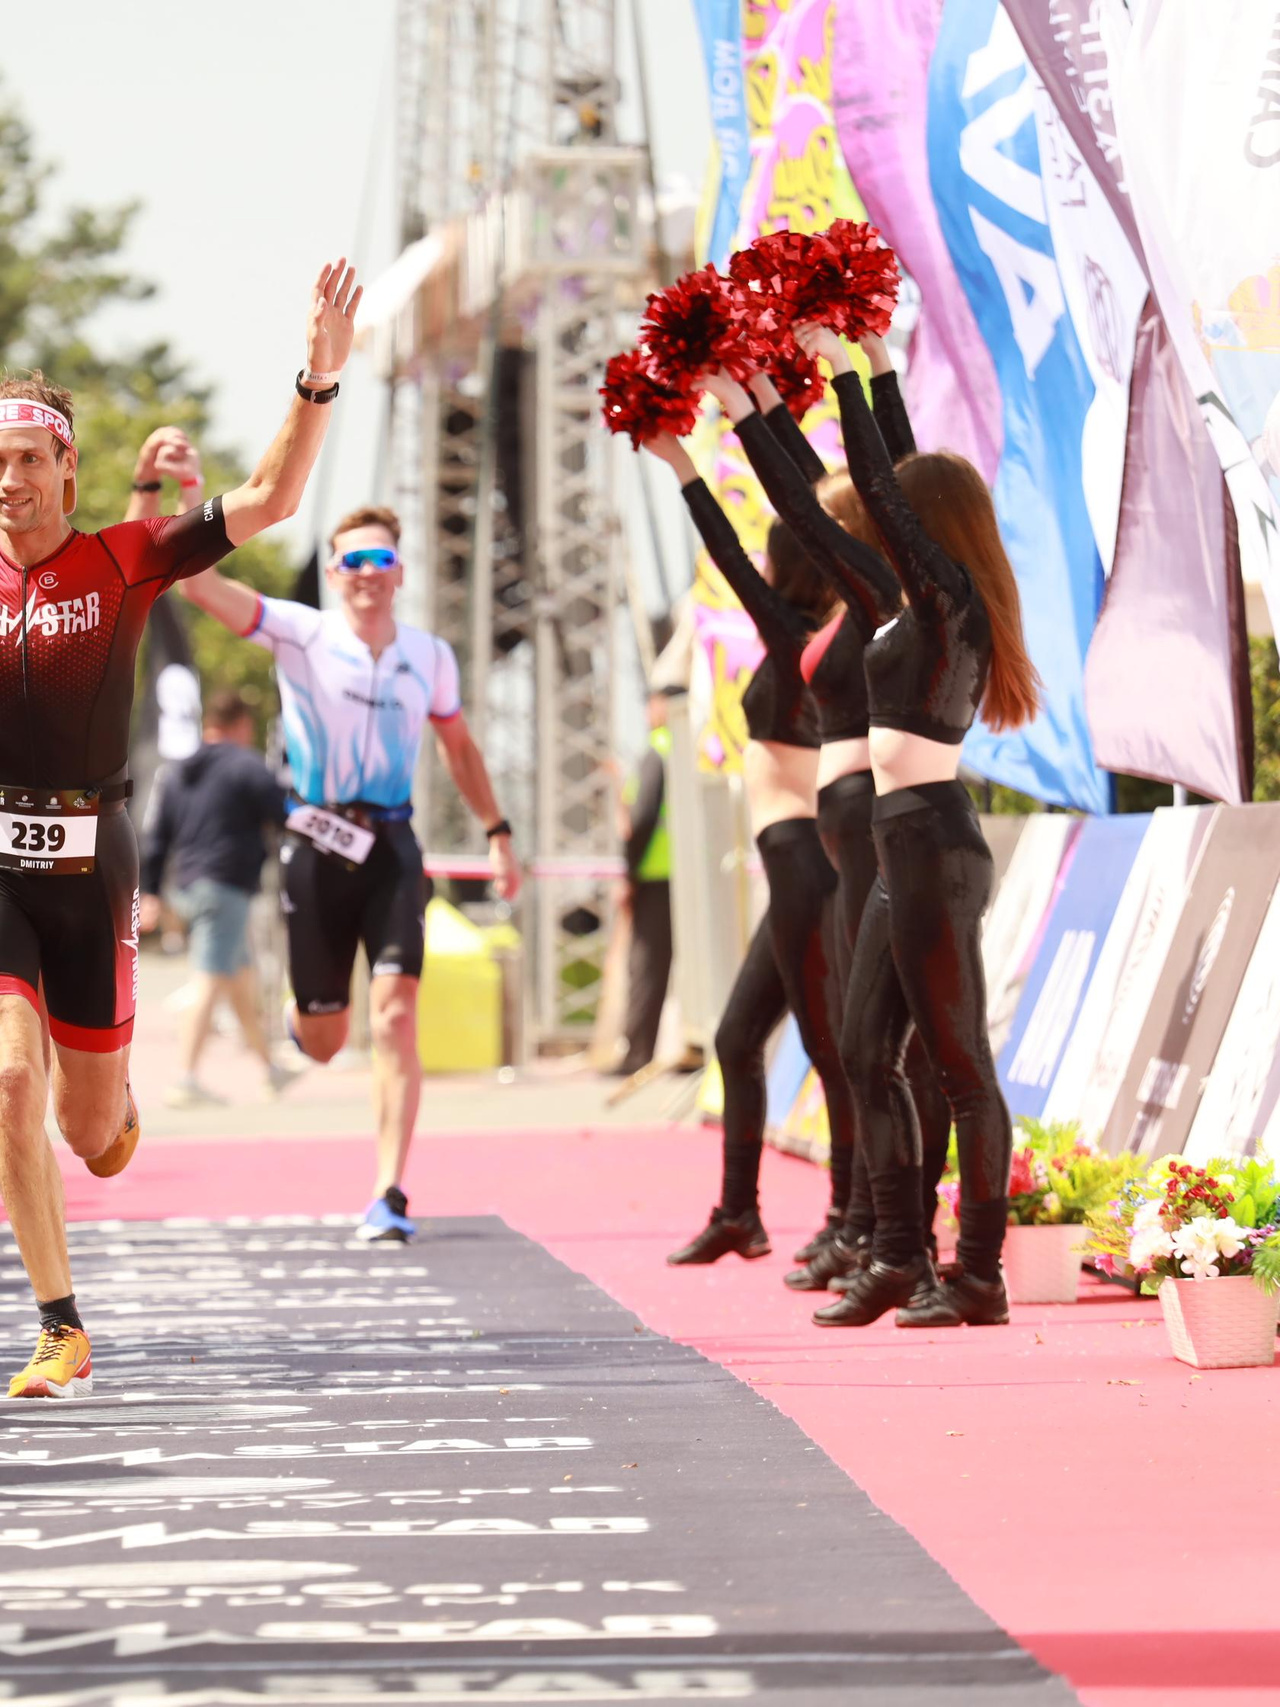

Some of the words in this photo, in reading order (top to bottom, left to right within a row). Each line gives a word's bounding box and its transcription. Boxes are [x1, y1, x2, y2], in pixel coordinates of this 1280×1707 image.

[41, 591, 100, 637] STAR
[11, 821, 66, 853] 239
[20, 858, 55, 870] DMITRIY
[232, 1436, 595, 1456] STAR
[242, 1516, 651, 1535] STAR
[256, 1614, 720, 1642] STAR
